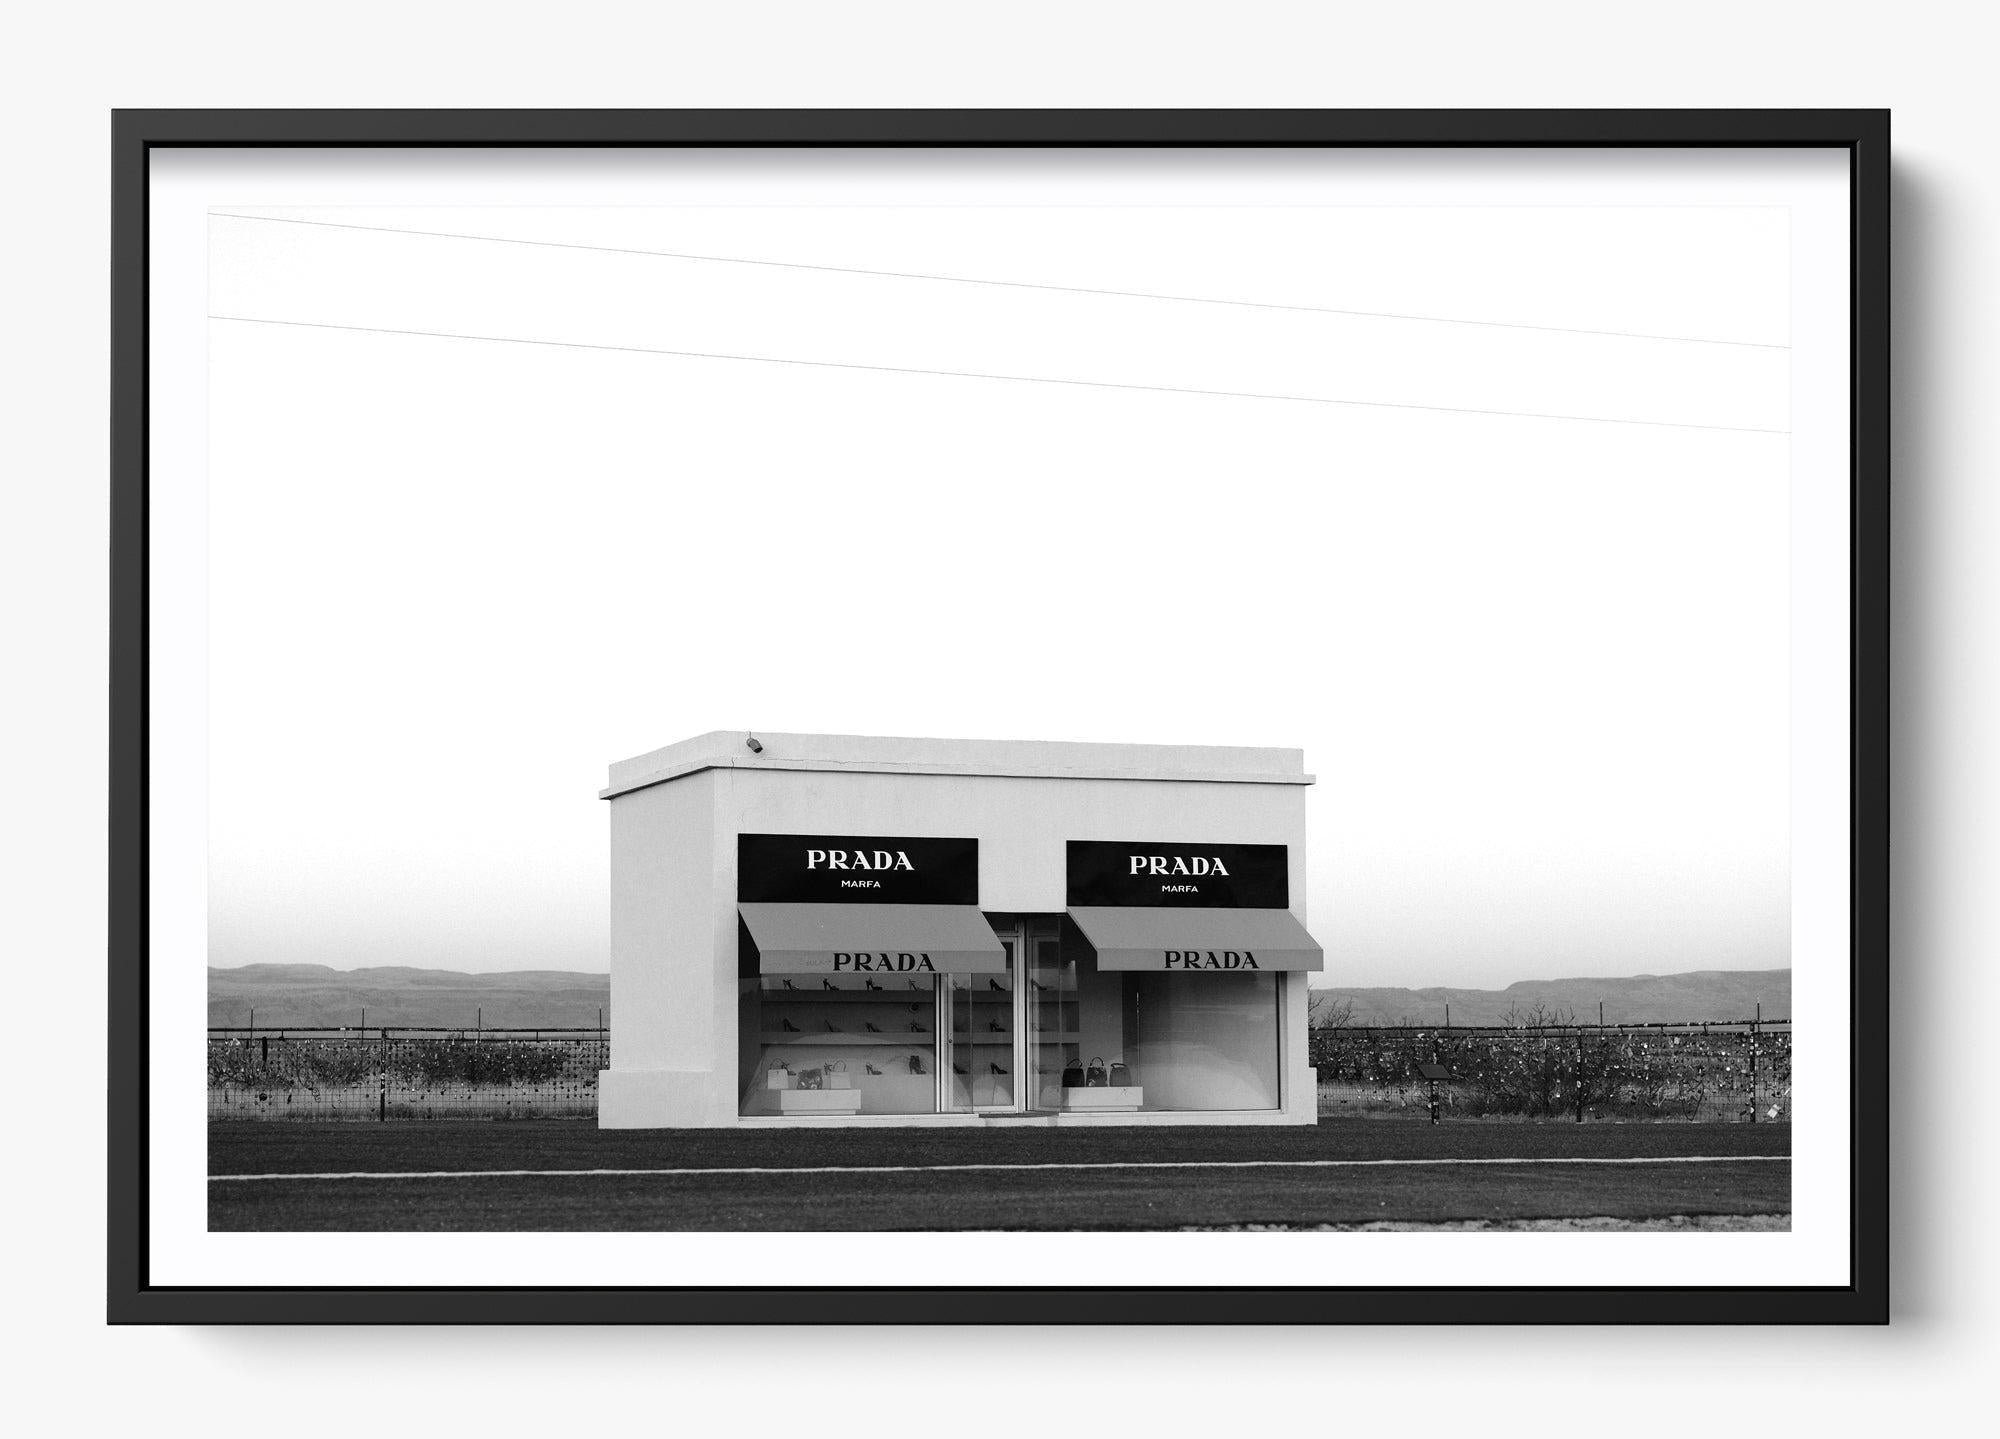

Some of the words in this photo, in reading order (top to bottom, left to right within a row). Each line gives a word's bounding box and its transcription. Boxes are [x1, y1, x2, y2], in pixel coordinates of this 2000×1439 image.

[806, 849, 915, 871] PRADA
[1129, 855, 1230, 876] PRADA
[841, 880, 881, 889] MARFA
[1161, 885, 1199, 893] MARFA
[833, 952, 937, 972] PRADA
[1164, 951, 1260, 969] PRADA
